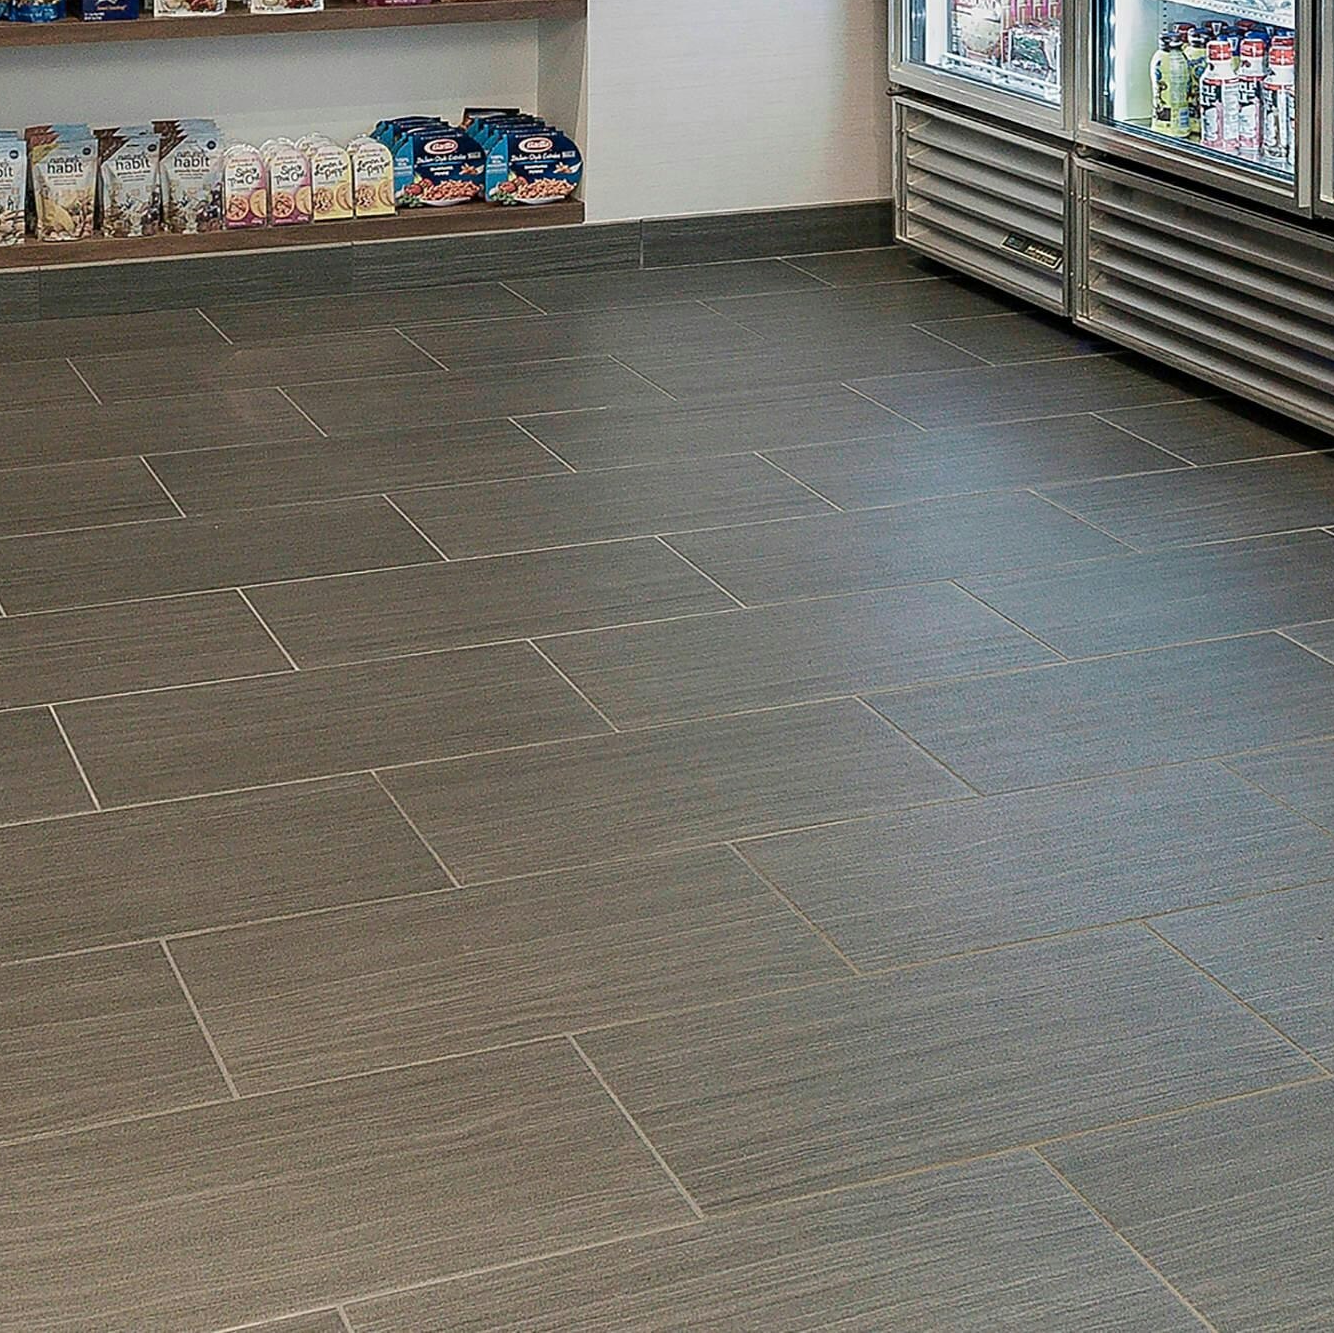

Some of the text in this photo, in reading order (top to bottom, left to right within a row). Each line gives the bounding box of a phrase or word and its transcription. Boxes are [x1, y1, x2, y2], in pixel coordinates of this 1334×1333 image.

[47, 162, 84, 174] habit
[115, 158, 152, 171] habit
[174, 157, 210, 169] habit
